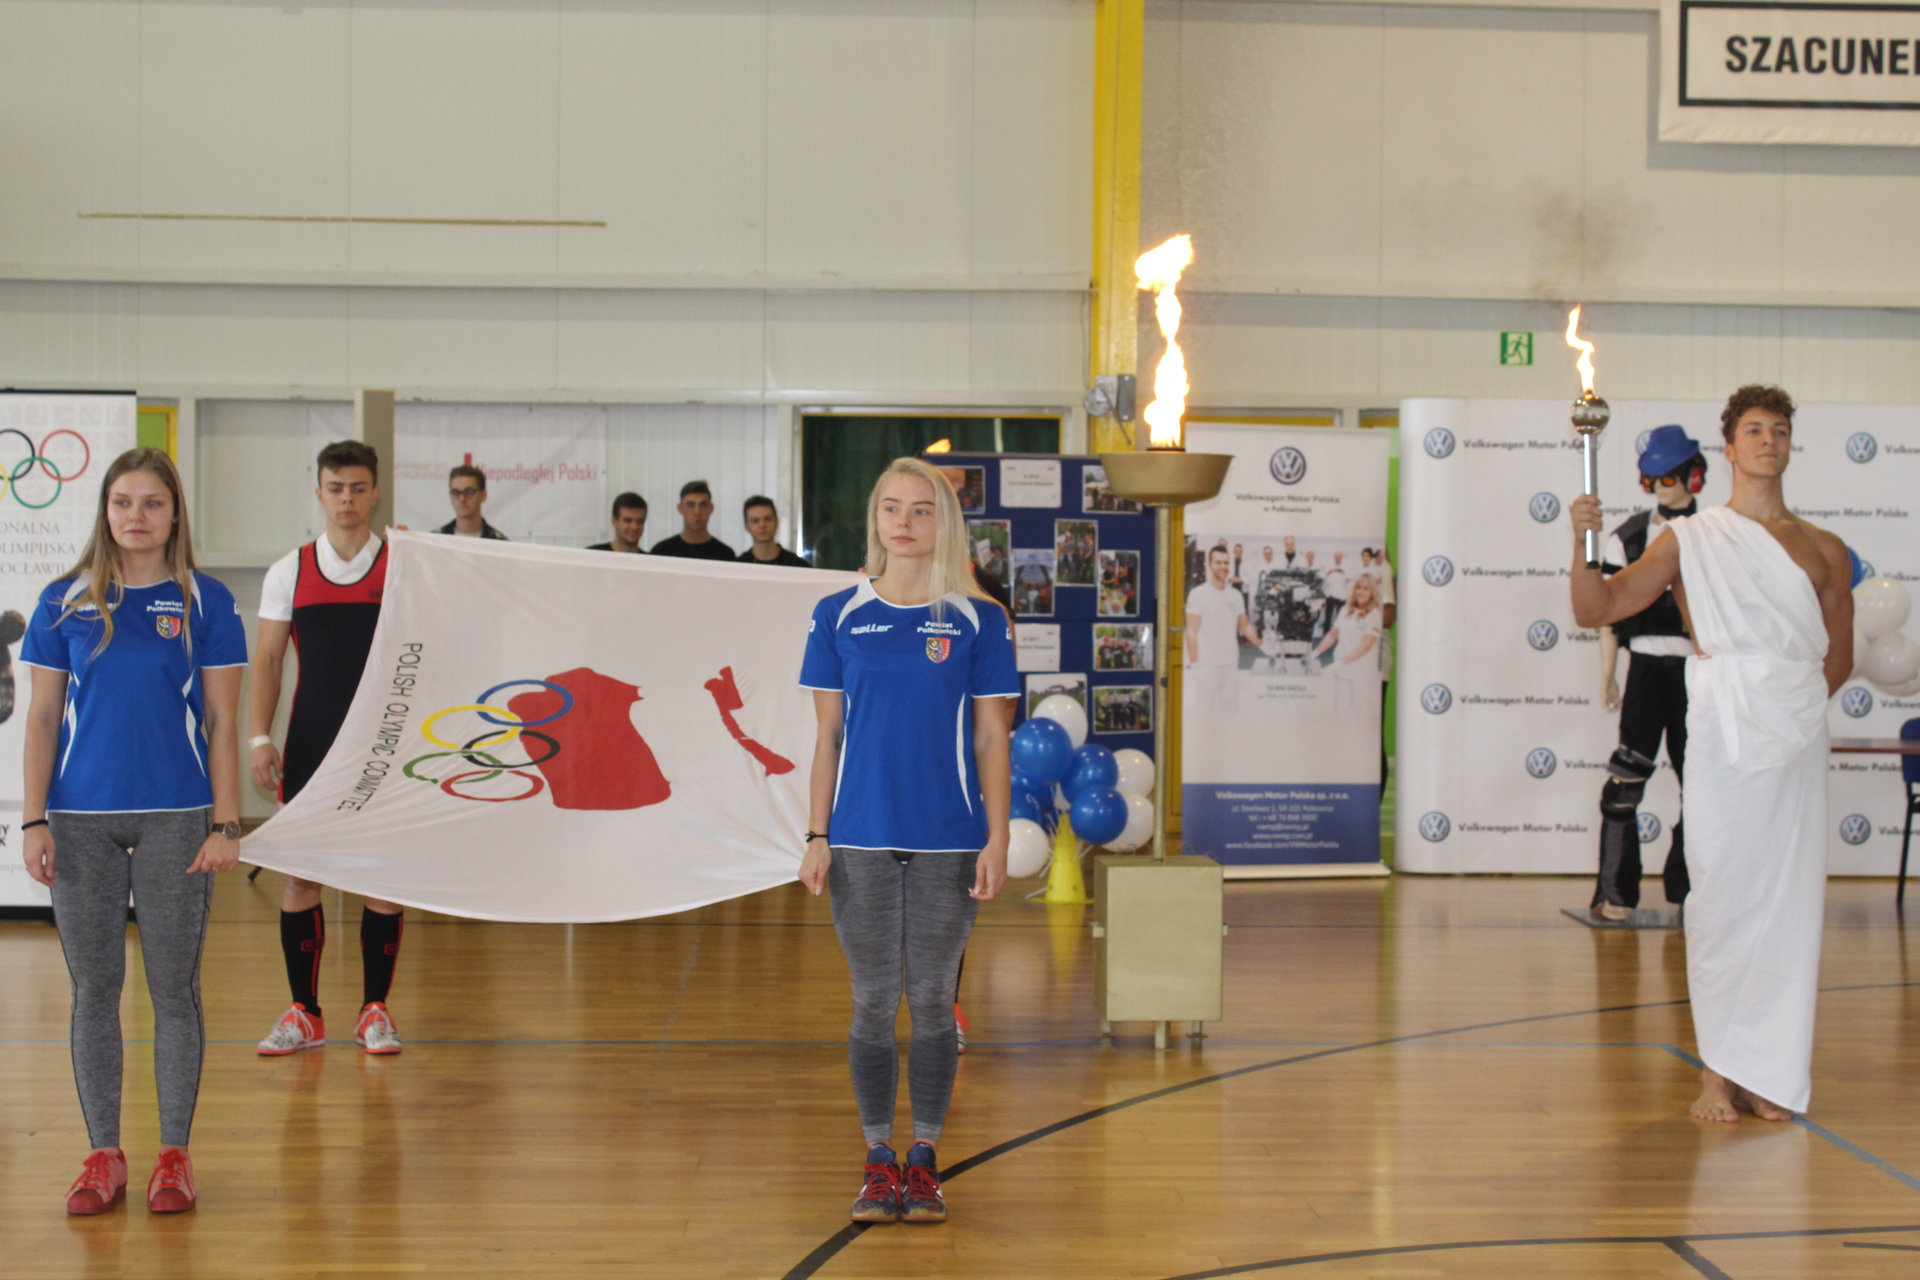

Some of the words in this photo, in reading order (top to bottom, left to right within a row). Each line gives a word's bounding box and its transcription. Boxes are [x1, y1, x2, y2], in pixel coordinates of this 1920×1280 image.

[1463, 439, 1526, 451] Volkswagen
[1528, 440, 1558, 449] Motor
[559, 464, 597, 481] Polski
[1792, 506, 1841, 518] lkswagen
[0, 542, 76, 556] LIMPIJSKA
[1461, 567, 1524, 579] Volkswagen
[1526, 568, 1556, 577] Motor
[146, 605, 185, 614] Polkowic
[925, 621, 953, 629] Powiat
[917, 627, 961, 636] Polkowicki
[390, 643, 423, 698] POLISH
[1460, 695, 1522, 706] Volkswagen
[1524, 696, 1554, 705] Motor
[1557, 696, 1590, 706] Polska
[372, 702, 409, 756] OLYMPIC
[1458, 823, 1520, 834] Volkswagen
[1523, 824, 1553, 832] Motor
[1555, 824, 1588, 833] Polska
